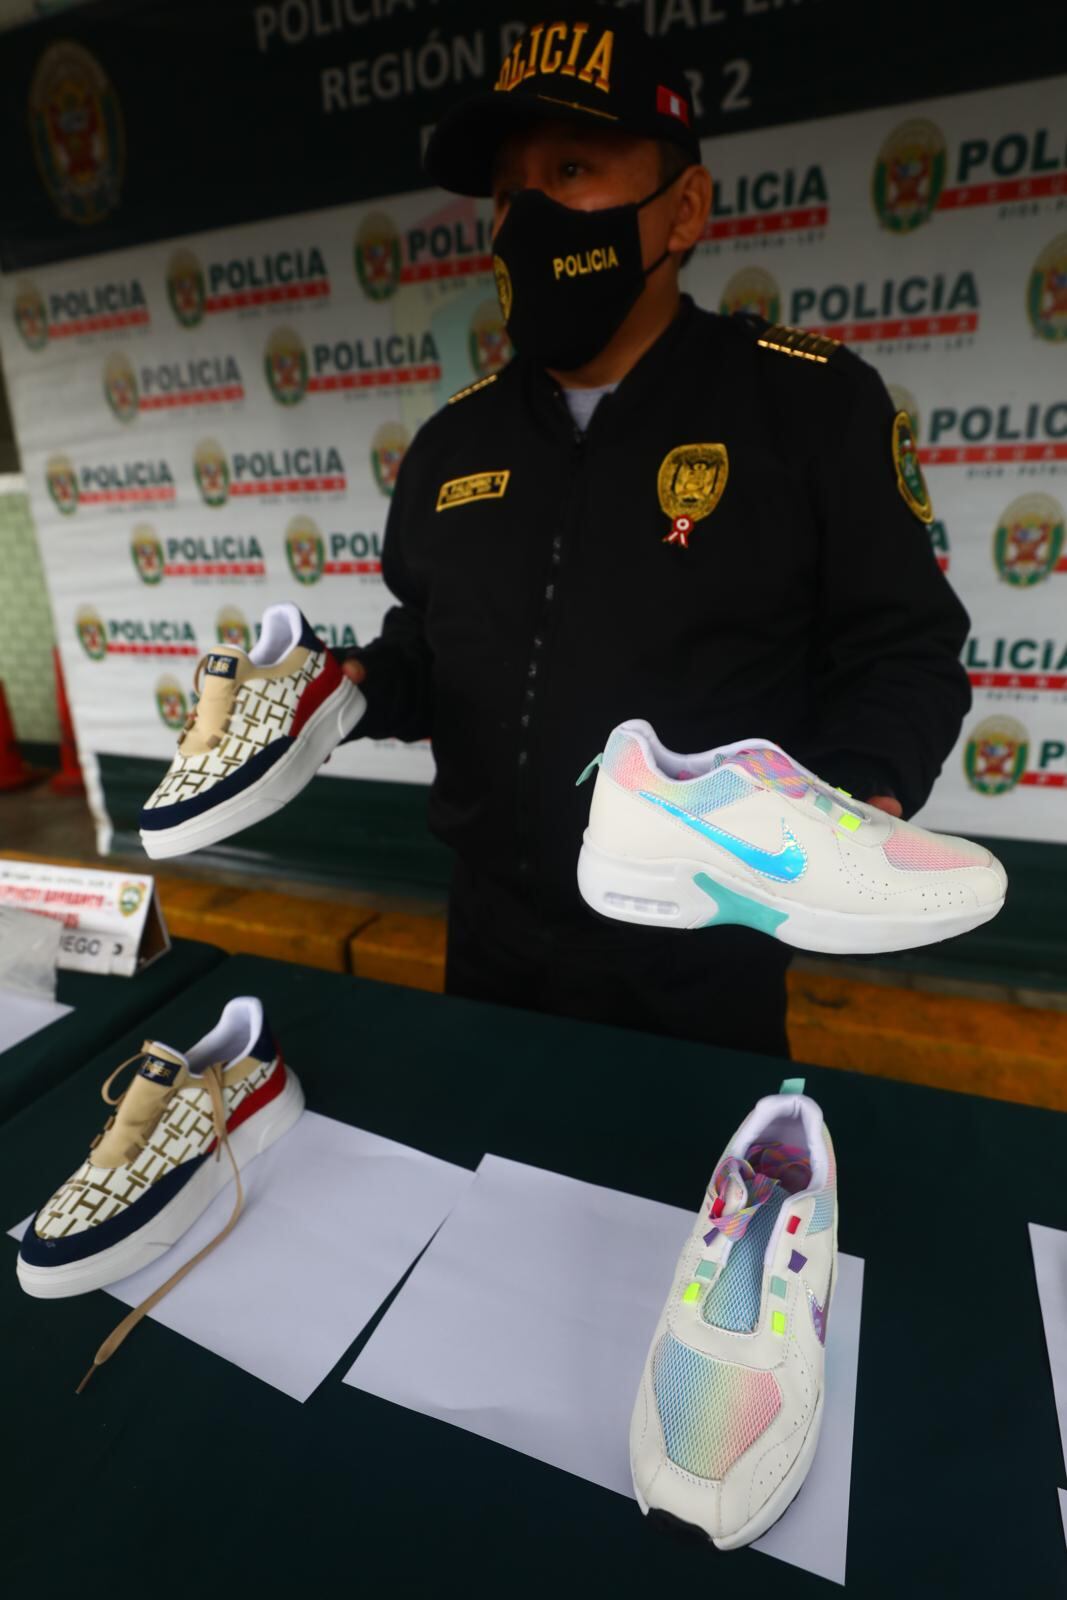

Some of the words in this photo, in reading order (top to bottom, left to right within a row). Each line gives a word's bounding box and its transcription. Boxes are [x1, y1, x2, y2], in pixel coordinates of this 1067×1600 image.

[320, 29, 486, 115] REGIÓN
[721, 57, 754, 113] 2
[956, 128, 1067, 182] POL
[712, 164, 829, 216] LICIA
[406, 218, 494, 262] POLI
[552, 245, 619, 281] POLICIA
[965, 636, 1067, 673] LICI
[60, 936, 101, 956] EGO
